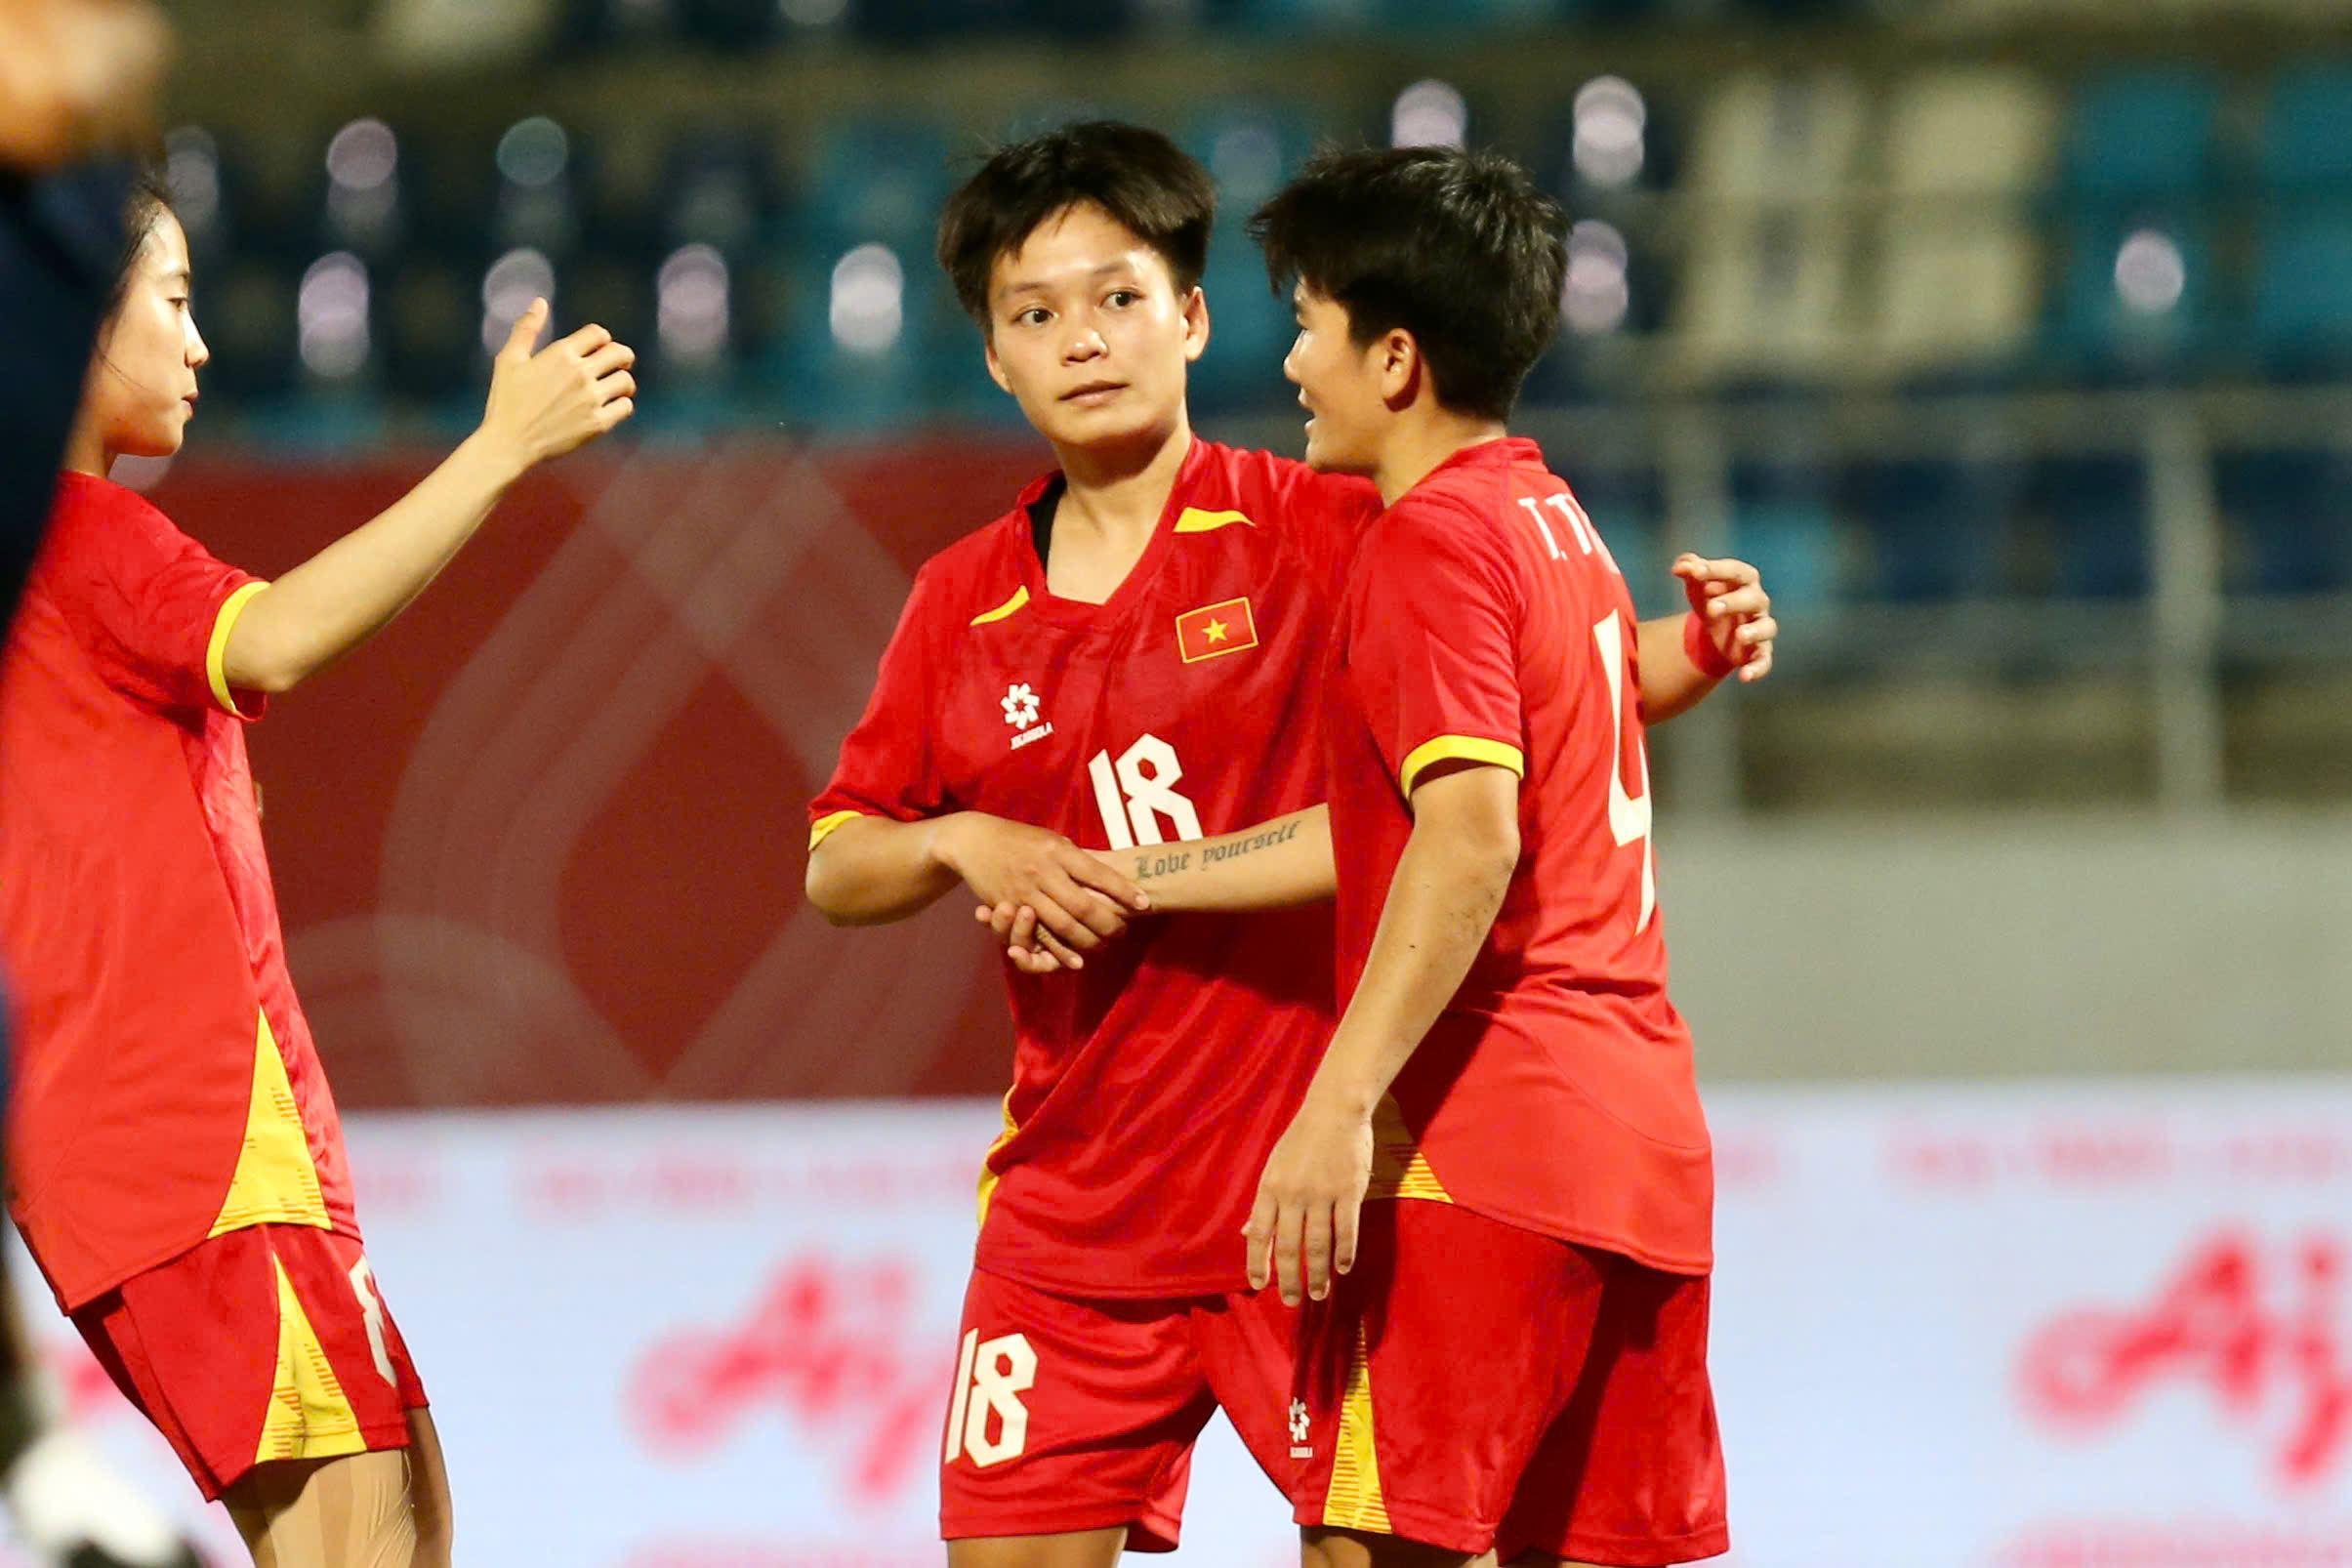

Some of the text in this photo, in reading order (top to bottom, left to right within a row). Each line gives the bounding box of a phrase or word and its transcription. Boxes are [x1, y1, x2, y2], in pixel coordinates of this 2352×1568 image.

[1087, 732, 1204, 851] 18
[1593, 608, 1656, 937] 4
[1135, 820, 1302, 881] Love yourself
[945, 1327, 1039, 1468] 18
